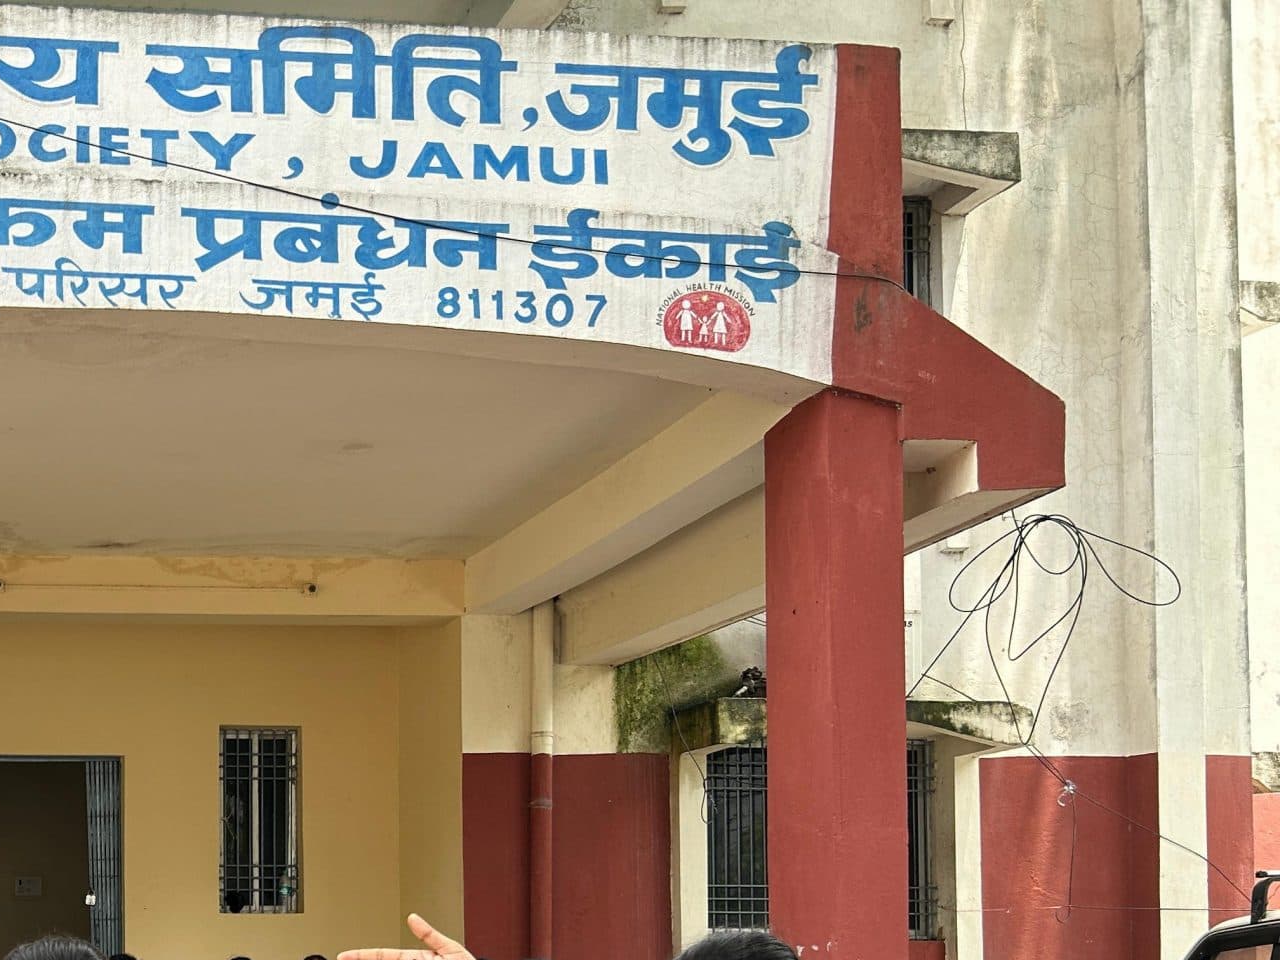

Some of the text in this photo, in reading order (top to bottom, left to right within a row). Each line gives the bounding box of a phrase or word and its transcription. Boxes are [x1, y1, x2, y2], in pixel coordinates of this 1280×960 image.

[546, 43, 819, 166] जमुई
[350, 141, 609, 185] JAMUI
[181, 193, 516, 273] प्रबंधन
[530, 210, 802, 303] ईकाई
[239, 272, 386, 321] जमुई
[437, 290, 609, 329] 811307
[656, 282, 756, 327] NATIONAL HEALTH MISSION
